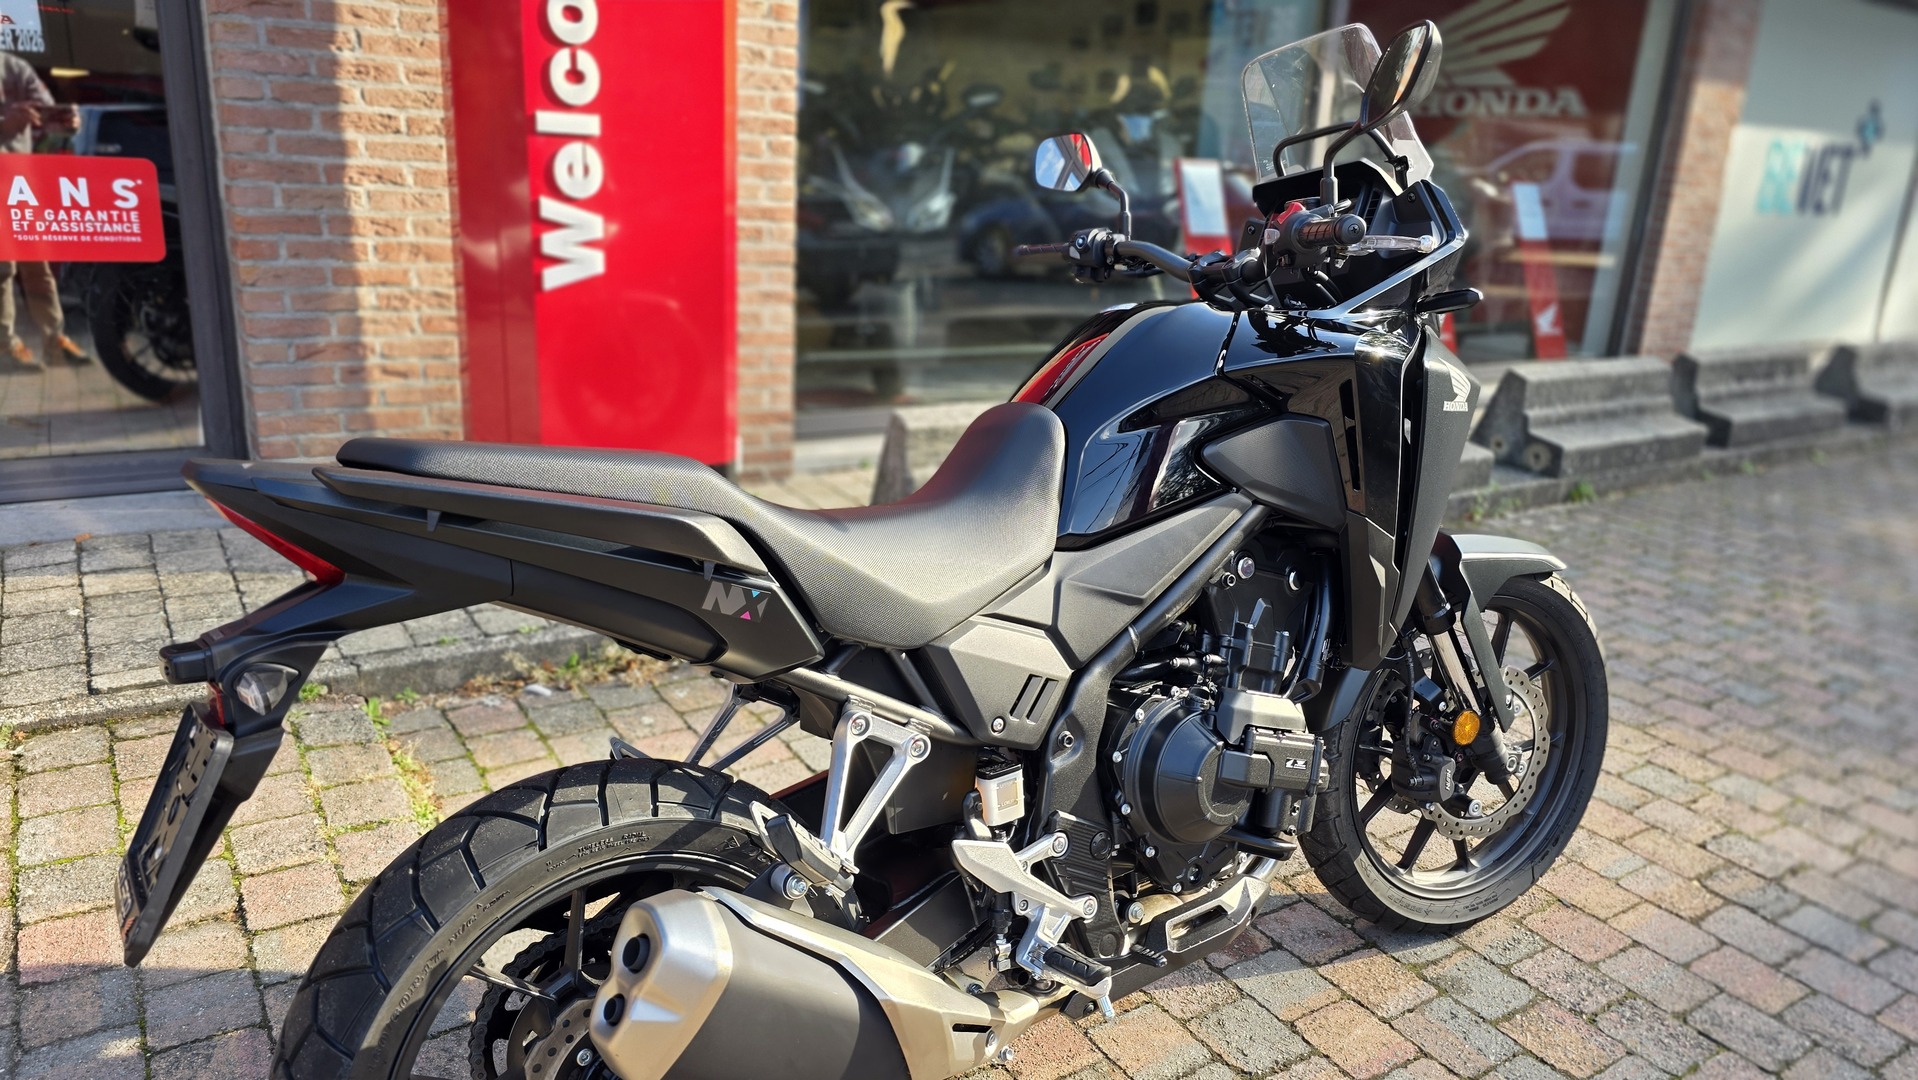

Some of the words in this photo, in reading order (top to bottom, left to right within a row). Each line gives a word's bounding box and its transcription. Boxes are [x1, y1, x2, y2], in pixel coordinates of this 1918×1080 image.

[534, 0, 605, 292] Welco
[10, 208, 34, 220] DE
[44, 209, 140, 222] GARANTIE
[12, 221, 30, 232] ET
[35, 221, 141, 234] D'ASSISTANCE
[93, 235, 142, 243] CONDITIONS
[1443, 400, 1469, 412] HONDA
